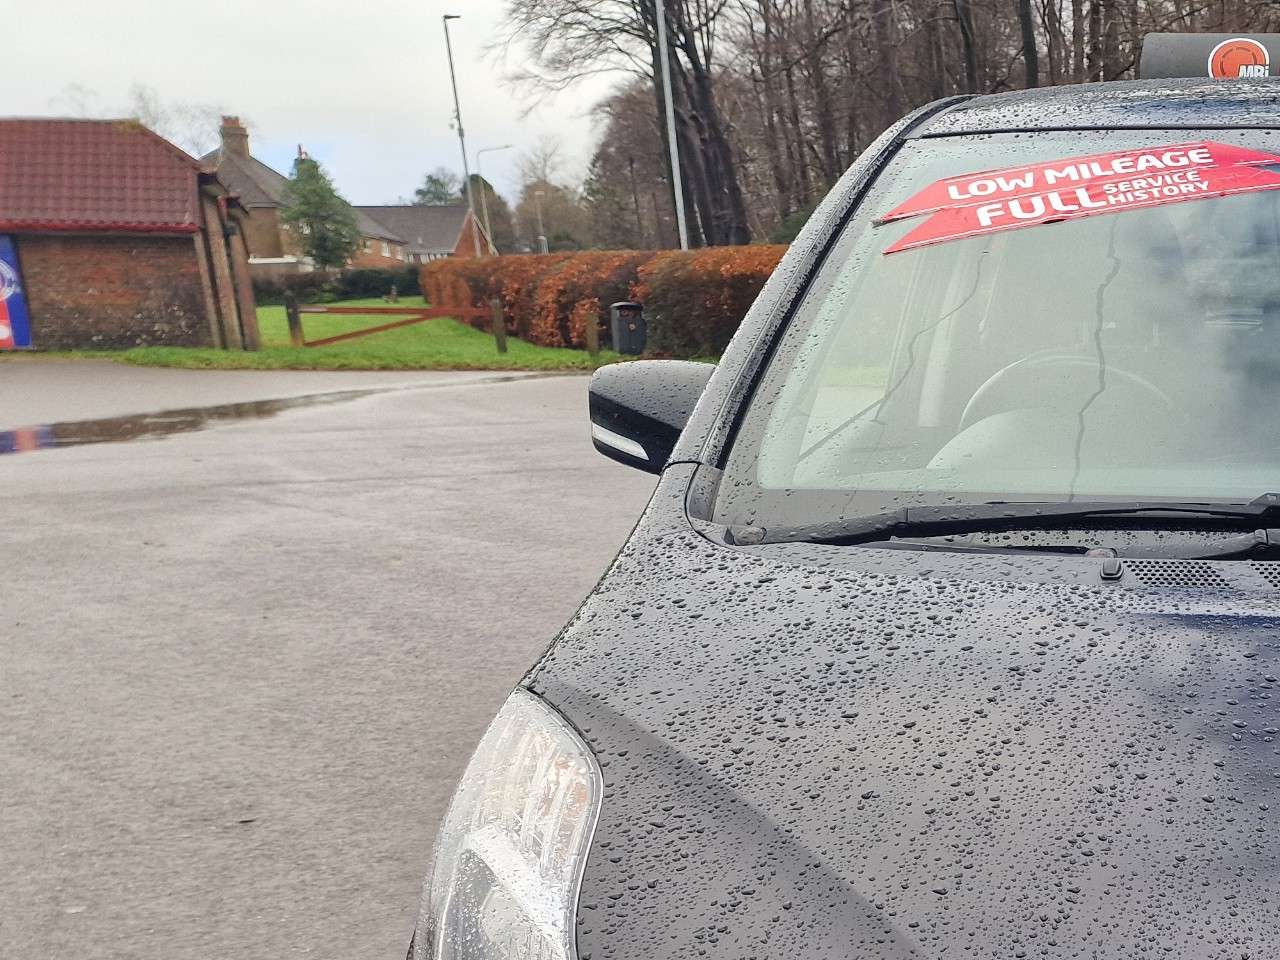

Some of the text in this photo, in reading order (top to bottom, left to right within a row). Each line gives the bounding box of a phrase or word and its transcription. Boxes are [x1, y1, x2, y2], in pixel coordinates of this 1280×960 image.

[947, 148, 1214, 201] LOW MILEAGE
[1103, 170, 1200, 195] SERVICE
[975, 189, 1107, 228] FULL
[1108, 180, 1210, 206] HISTORY
